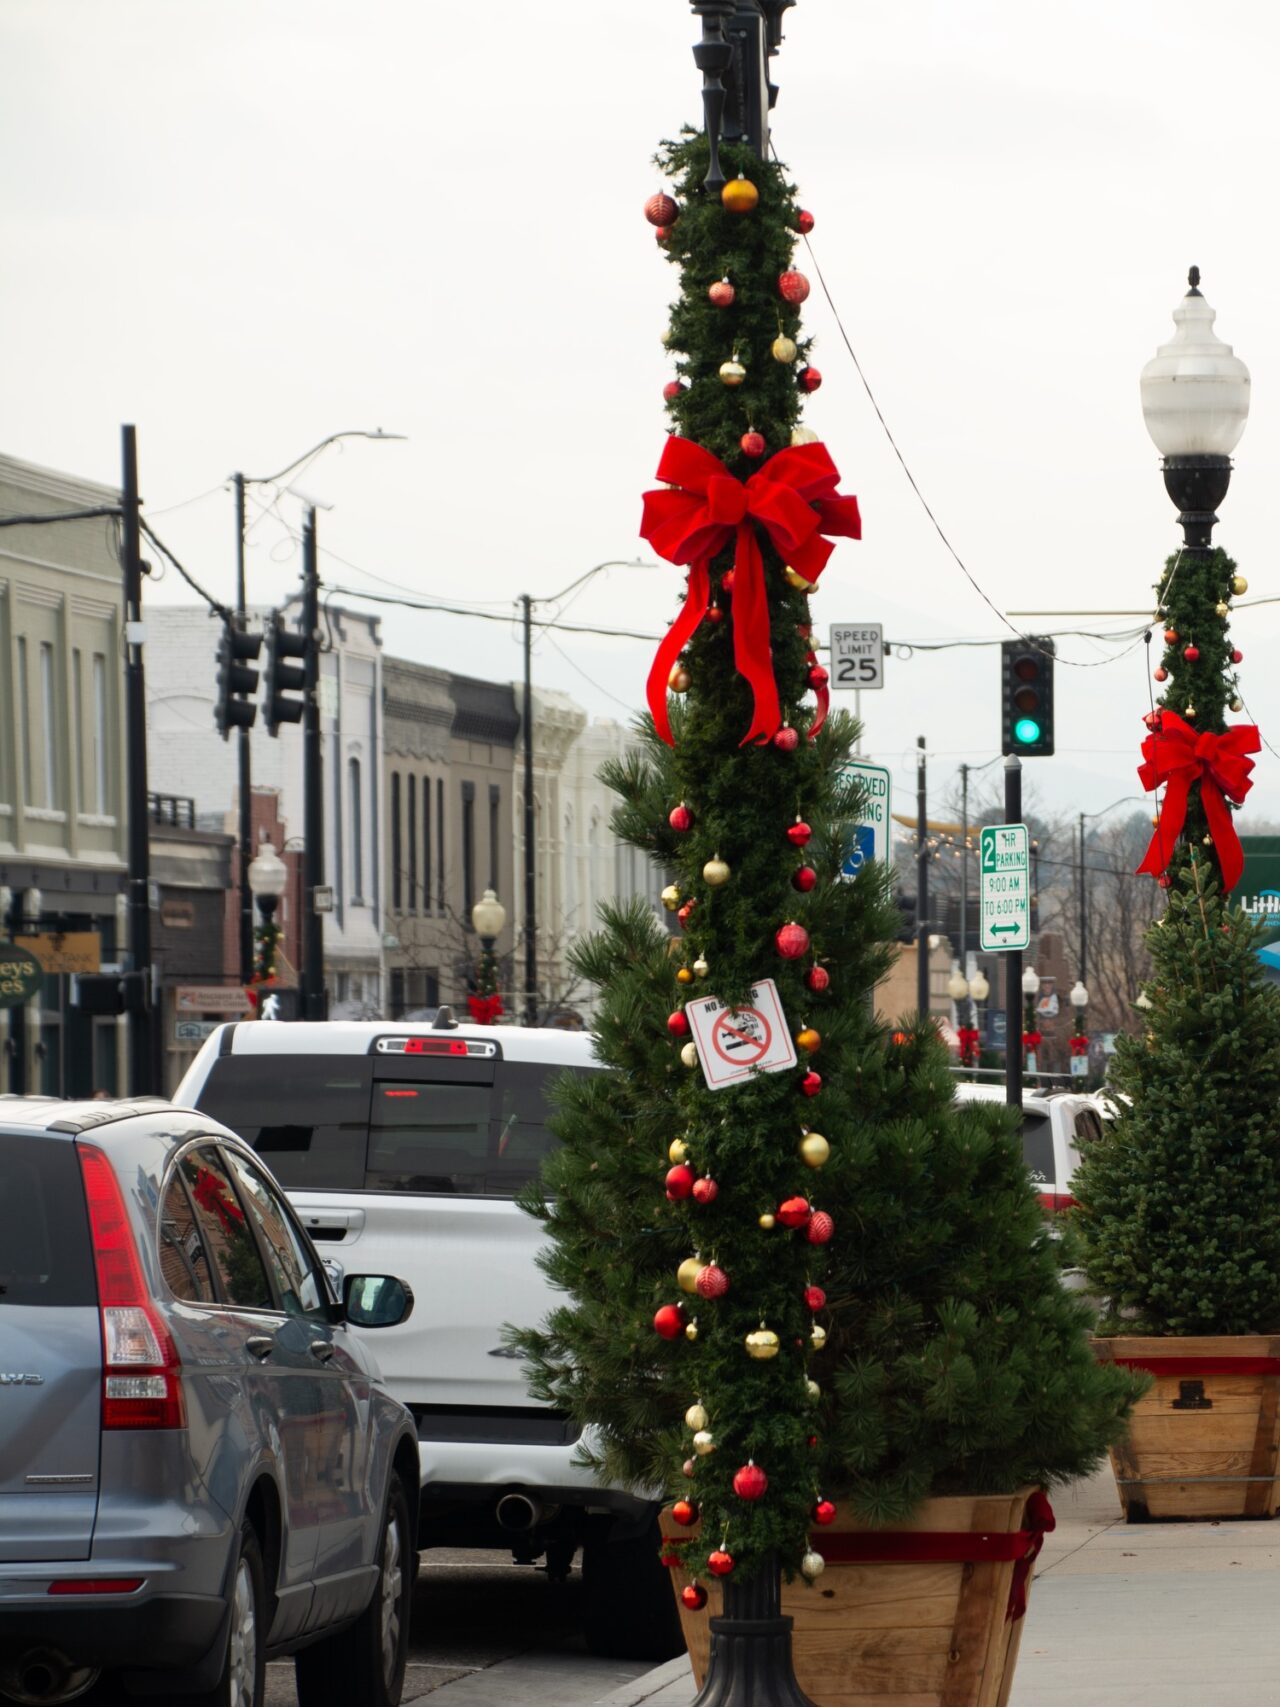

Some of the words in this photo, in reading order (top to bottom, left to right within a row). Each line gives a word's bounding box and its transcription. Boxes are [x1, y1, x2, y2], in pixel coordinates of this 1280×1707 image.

[834, 630, 879, 641] SPEED
[839, 644, 873, 655] LIMIT
[837, 658, 878, 682] 25
[983, 836, 995, 867] 2
[1004, 832, 1017, 848] HR
[996, 851, 1026, 868] PARKING
[989, 877, 1006, 893] 9:00
[1009, 876, 1020, 891] AM
[985, 901, 994, 916] TO
[997, 900, 1013, 915] 6:00
[1015, 899, 1026, 913] PM
[704, 1001, 718, 1013] NO
